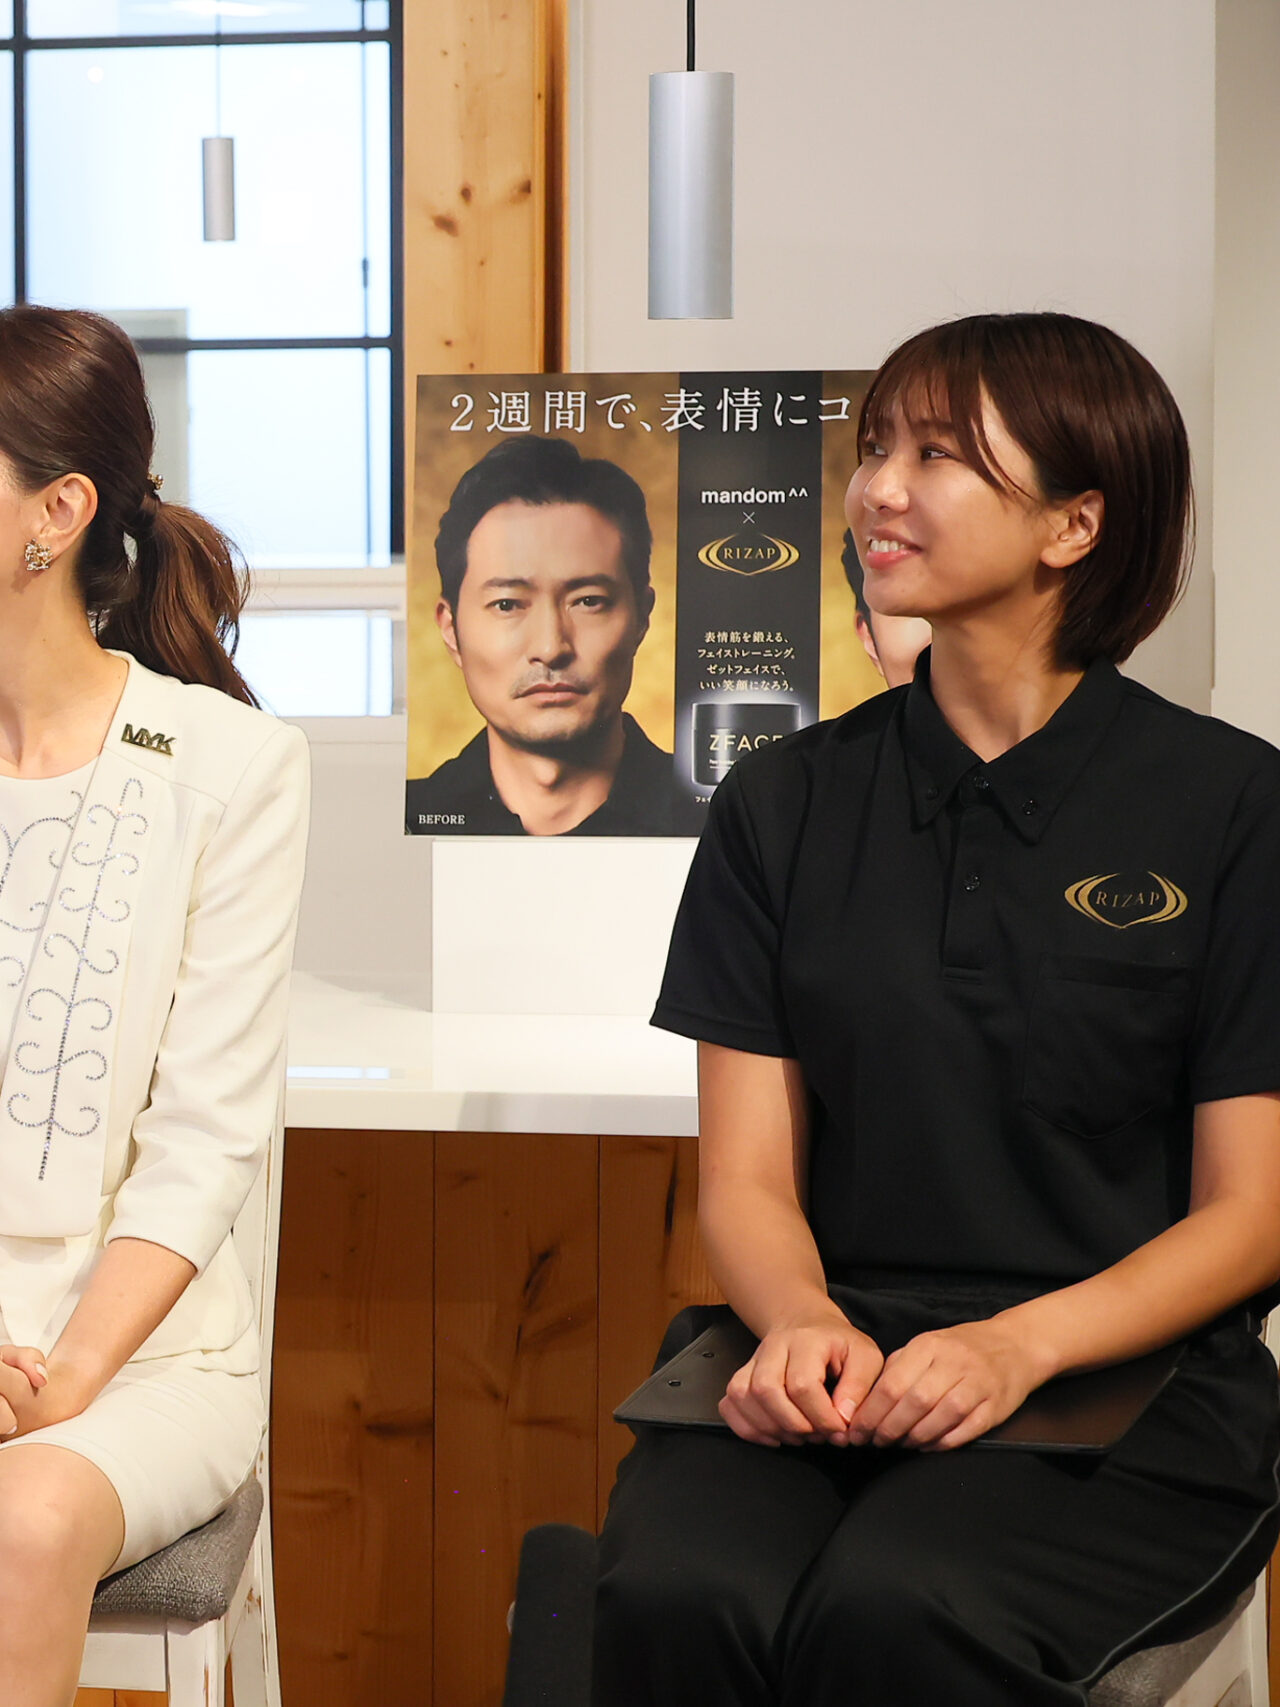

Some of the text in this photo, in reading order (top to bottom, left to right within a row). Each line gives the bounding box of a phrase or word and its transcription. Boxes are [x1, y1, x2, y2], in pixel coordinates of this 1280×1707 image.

[723, 547, 776, 560] RIZAP
[418, 814, 466, 825] BEFORE
[1095, 891, 1161, 908] RIZAP
